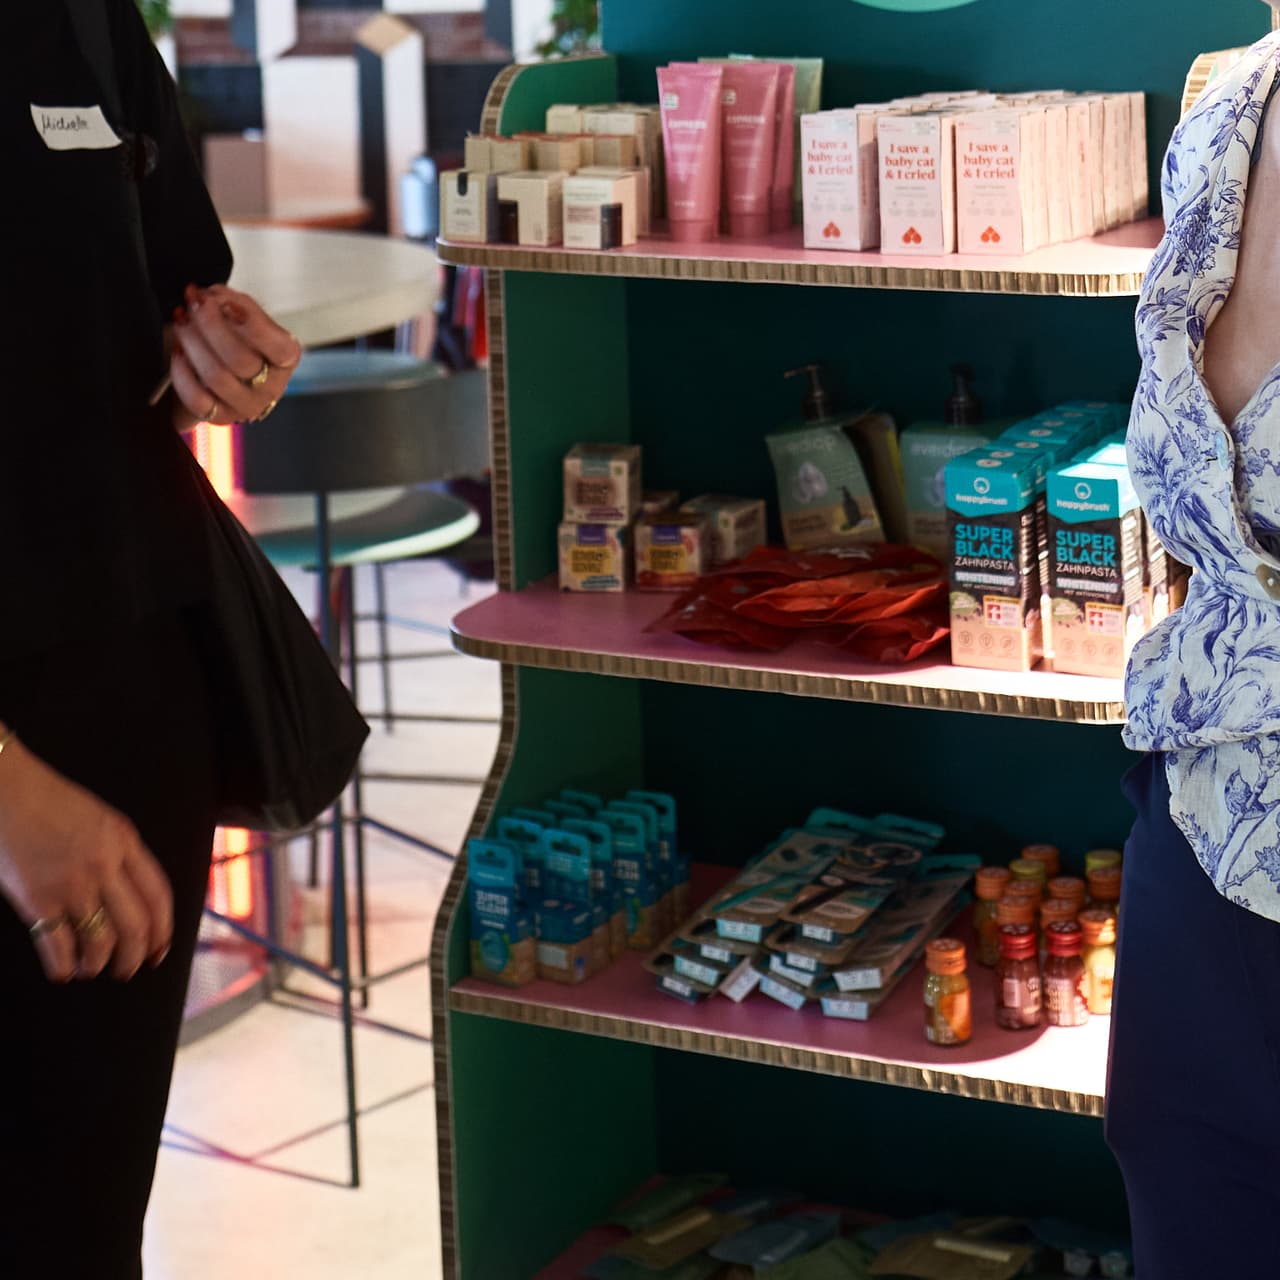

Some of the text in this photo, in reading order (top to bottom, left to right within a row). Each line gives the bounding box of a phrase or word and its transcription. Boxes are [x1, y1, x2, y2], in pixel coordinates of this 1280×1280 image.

[819, 140, 839, 150] saw
[897, 145, 920, 154] saw
[976, 143, 999, 152] saw
[807, 152, 853, 165] baby cat
[885, 155, 935, 169] baby cat
[963, 154, 1014, 167] baby cat
[824, 165, 854, 176] cried
[904, 169, 936, 181] cried
[983, 168, 1016, 179] cried
[955, 523, 1014, 545] SUPER
[1055, 529, 1116, 552] SUPER
[955, 540, 1015, 561] BLACK
[1056, 546, 1117, 567] BLACK
[954, 556, 1015, 571] ZAHNPASTA
[1056, 562, 1118, 578] ZAHNPASTA
